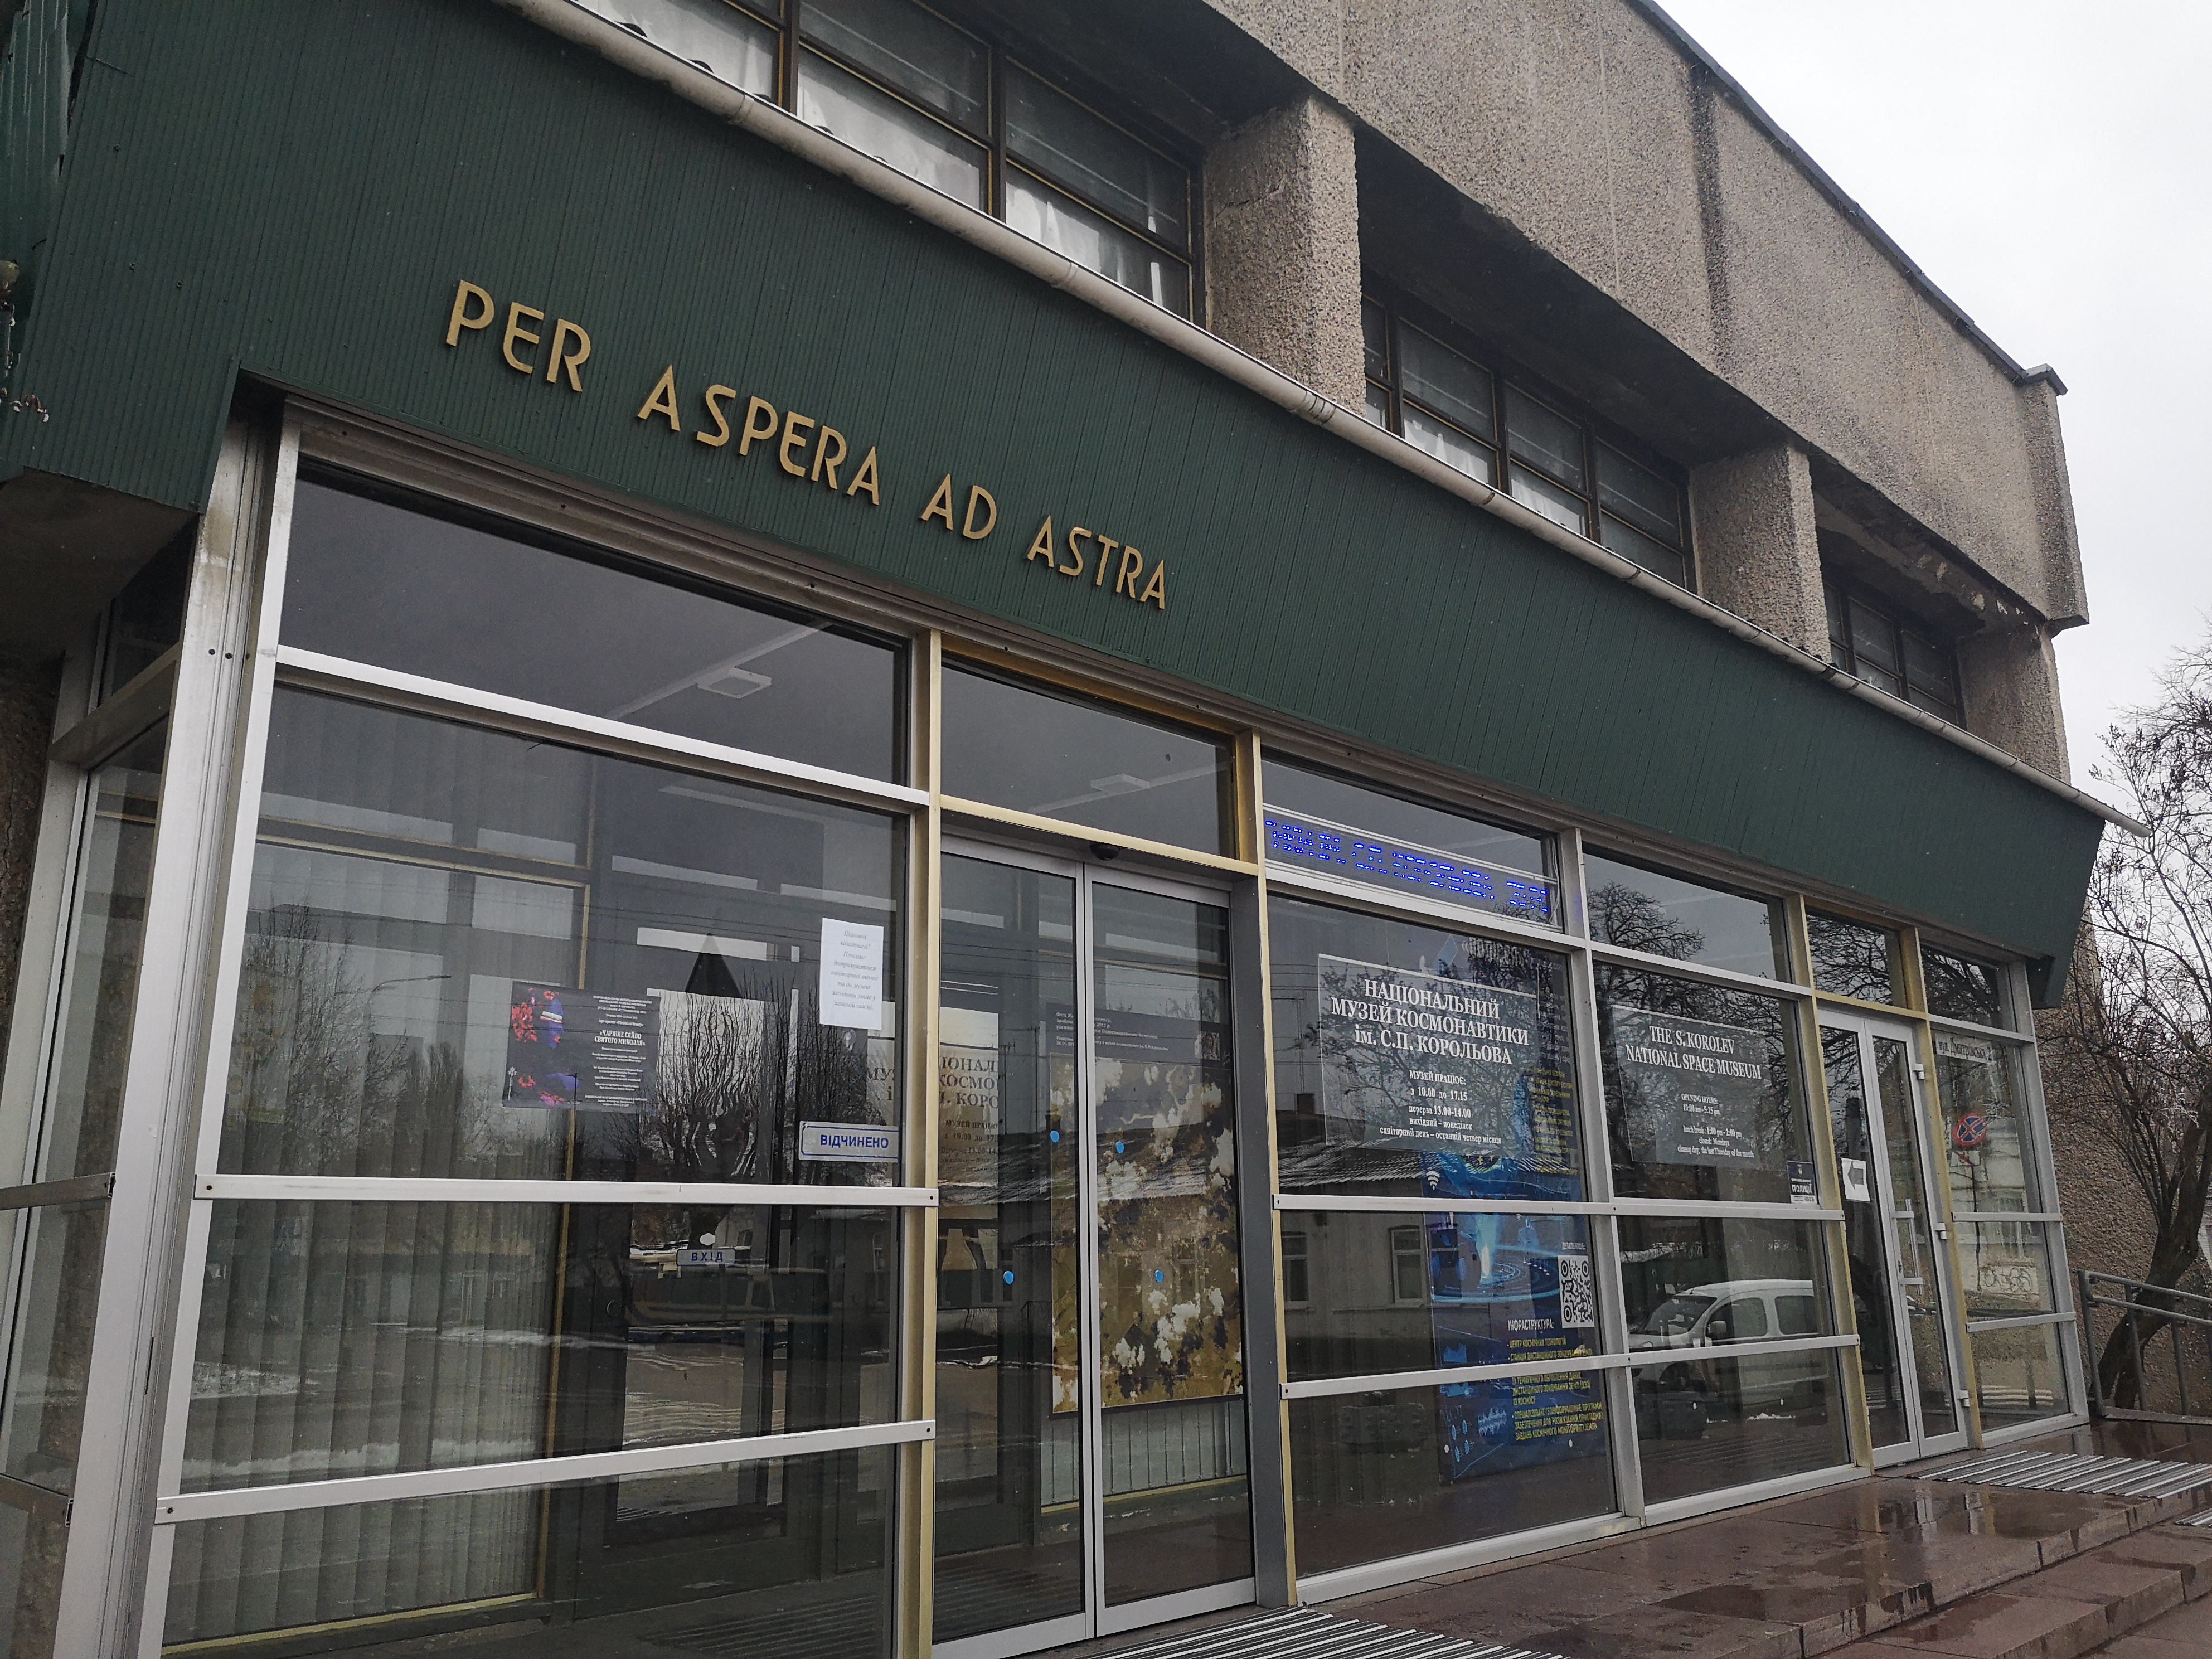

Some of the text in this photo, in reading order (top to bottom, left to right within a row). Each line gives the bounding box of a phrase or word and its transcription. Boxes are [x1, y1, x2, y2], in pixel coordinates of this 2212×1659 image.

[446, 279, 1165, 609] PER ASPERA AD ASTRA
[1364, 979, 1500, 1019] НАЦІОНАЛЬНИЙ
[1331, 997, 1392, 1024] МУЗЕЙ
[1395, 1008, 1530, 1046] КОСМОНАВТИКИ
[618, 1038, 645, 1046] МИКОЛАЯ»
[1354, 1024, 1377, 1045] ім.
[1417, 1035, 1513, 1065] КОРОЛЬОВА
[1648, 1025, 1735, 1054] THE S. KOROLEV
[1625, 1044, 1762, 1080] NATIONAL SPACE MUSEUM
[1409, 1070, 1467, 1085] МУЗЕЙ ПРАЦЮЄ:
[1418, 1088, 1435, 1098] 10.00
[1439, 1091, 1447, 1099] до
[1451, 1090, 1468, 1102] 17.15
[1681, 1093, 1701, 1103] OPENING
[1409, 1105, 1471, 1118] перерва 13.00-14.00
[1682, 1103, 1695, 1112] 10:00
[1704, 1105, 1713, 1114] 5:15
[1409, 1117, 1438, 1127] вихідний
[1443, 1122, 1473, 1131] понеділок
[1380, 1126, 1414, 1138] санітарний
[1415, 1131, 1430, 1139] день
[1435, 1132, 1462, 1141] останній
[1462, 1134, 1482, 1145] четвер
[1482, 1134, 1502, 1144] місяця
[1706, 1127, 1716, 1135] 1:00
[1726, 1128, 1735, 1137] 2:00
[820, 1134, 889, 1148] ВІДЧИНЕНО
[691, 1251, 723, 1262] ВХІД
[1507, 1318, 1554, 1332] ІНФРАСТРУКТУРА:
